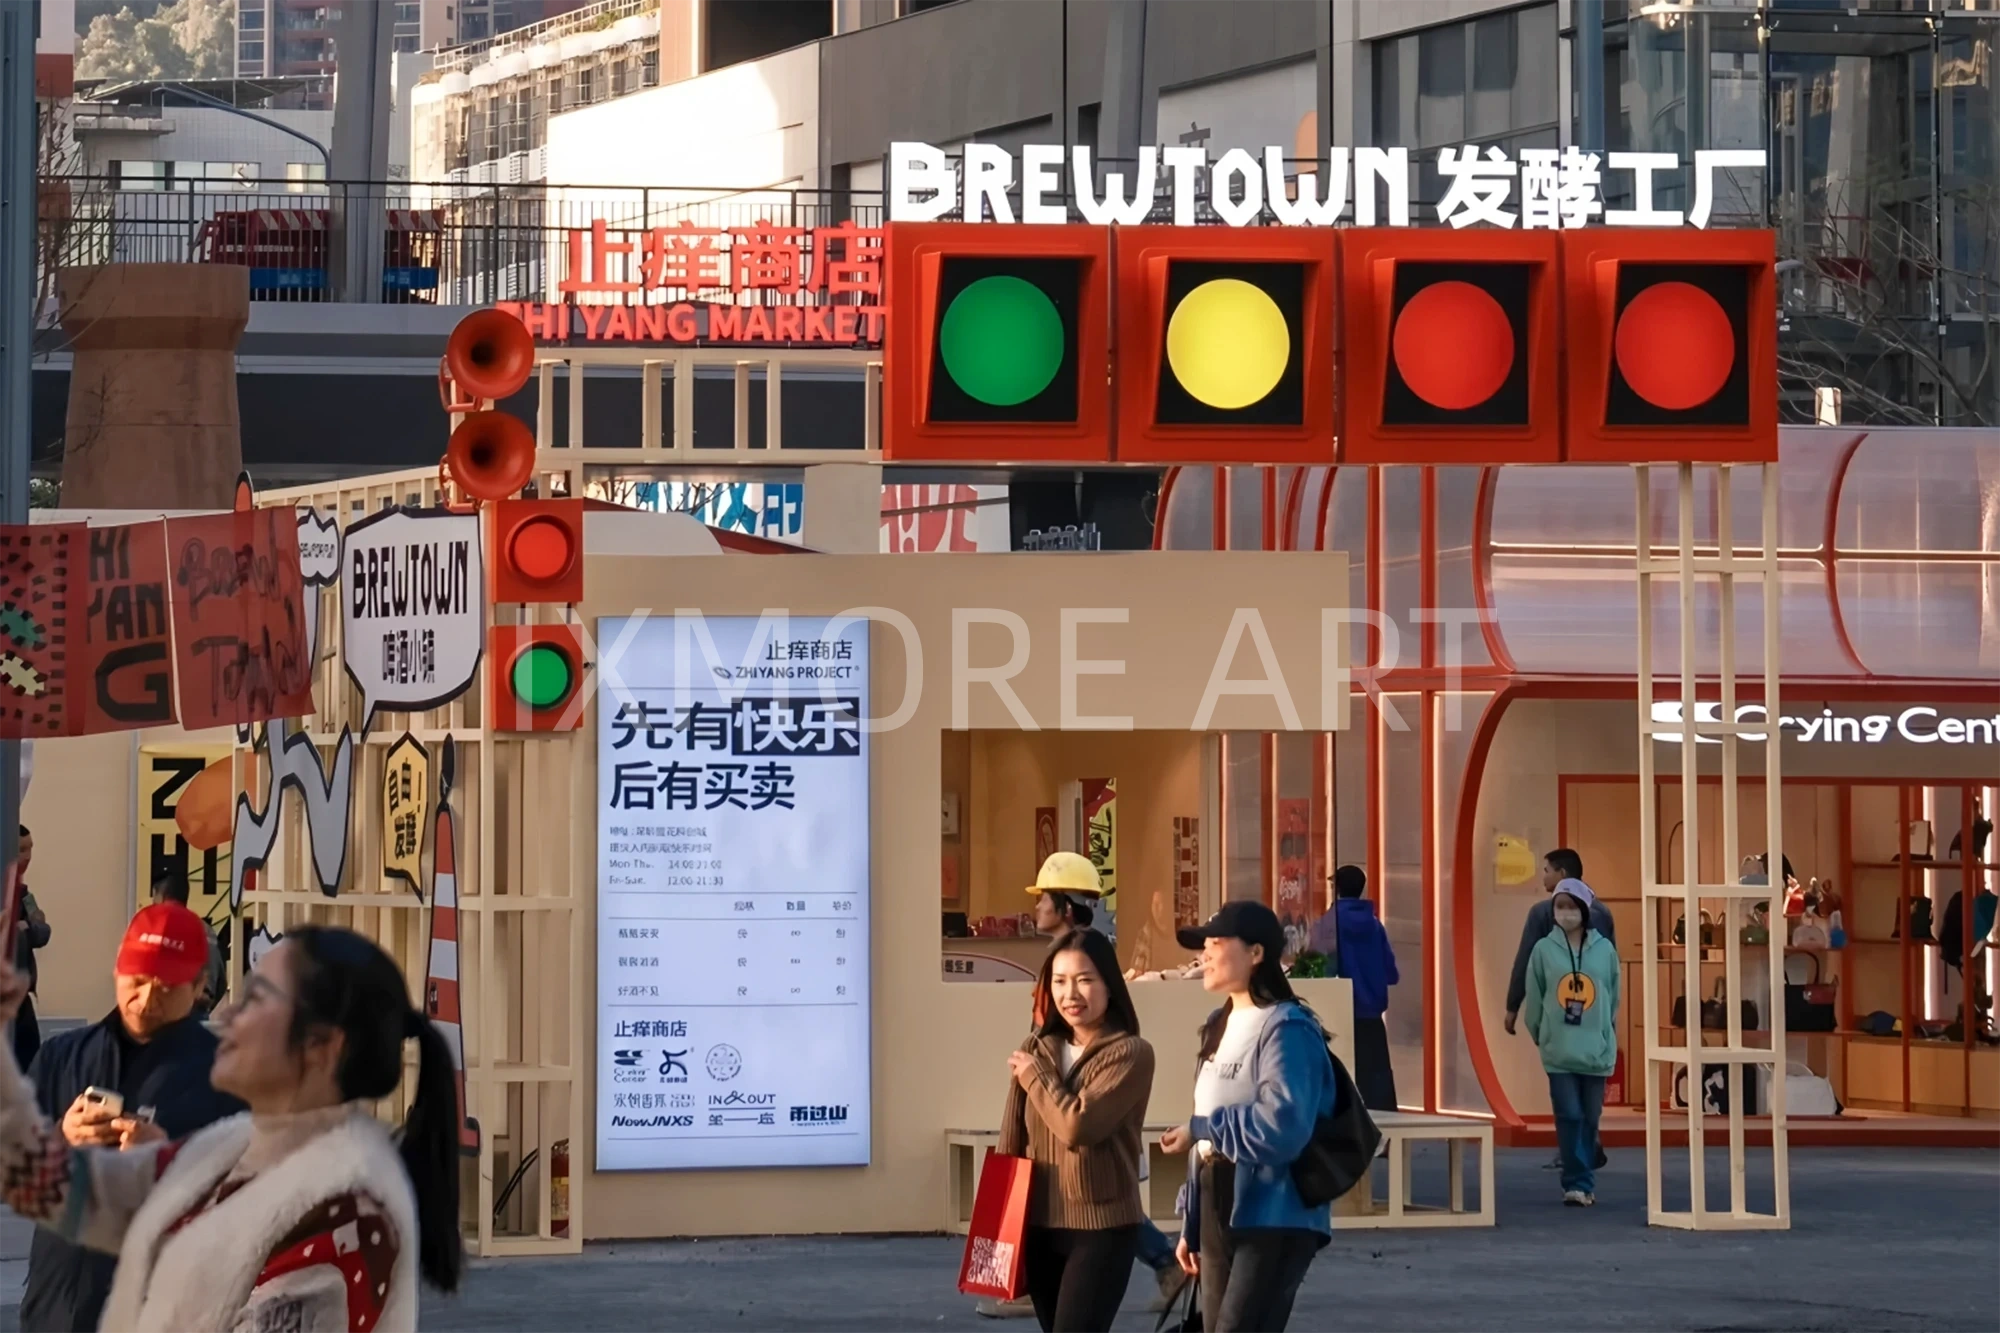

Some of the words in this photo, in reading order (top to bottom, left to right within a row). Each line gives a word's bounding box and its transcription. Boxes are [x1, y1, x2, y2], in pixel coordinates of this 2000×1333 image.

[890, 141, 1408, 227] BREWTOWN
[1435, 145, 1766, 229] 发酵工厂
[558, 219, 885, 294] 止痒商店
[578, 304, 697, 342] YANG
[708, 304, 887, 342] MARKET
[353, 541, 468, 619] BREWTOWN
[766, 639, 853, 661] 止痒商店
[797, 665, 852, 679] PROJECT
[611, 701, 860, 752] 先有快乐
[609, 760, 796, 811] 后有买卖
[613, 1020, 688, 1038] 止痒商店
